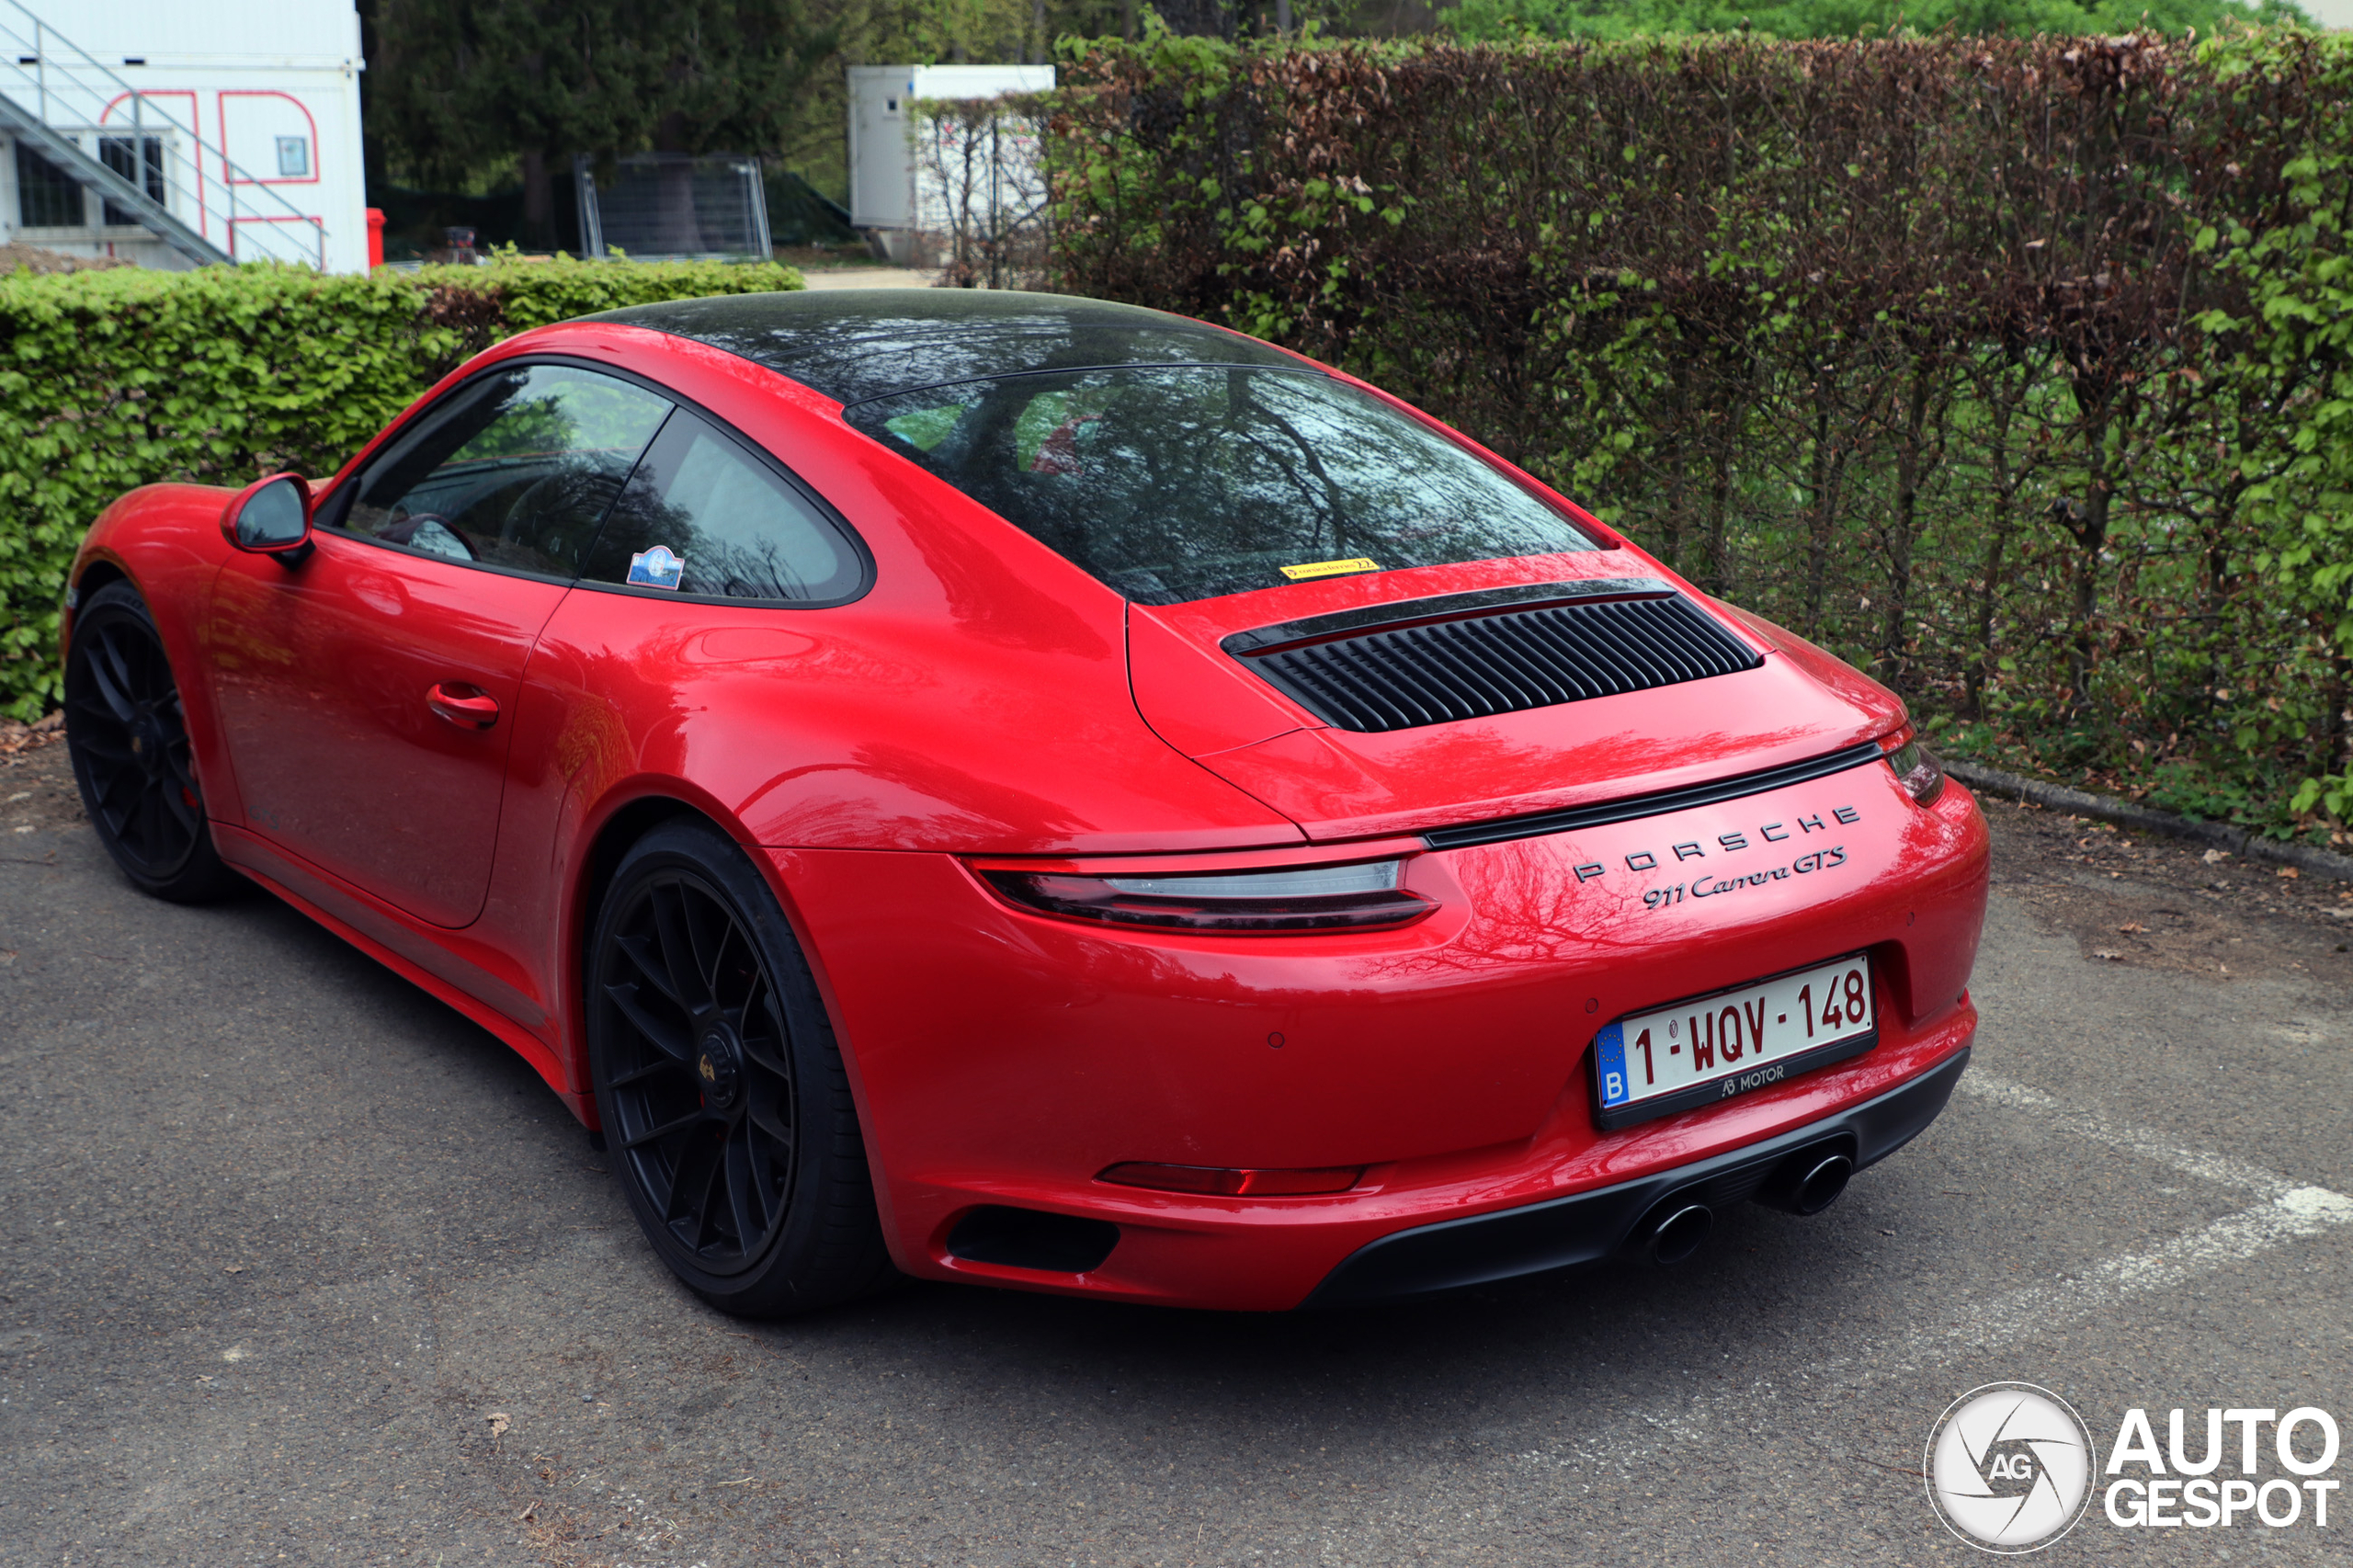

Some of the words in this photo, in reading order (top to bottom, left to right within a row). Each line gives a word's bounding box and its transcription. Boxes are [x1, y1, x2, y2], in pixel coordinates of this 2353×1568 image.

[1353, 560, 1375, 569] 22
[1574, 805, 1861, 883] PORSCHE
[1643, 882, 1686, 910] 911
[1692, 867, 1791, 898] Carrera
[1792, 846, 1847, 875] GTS
[1635, 969, 1866, 1085] 1-WQV-148
[1606, 1072, 1623, 1100] B
[1740, 1064, 1784, 1091] MOTOR
